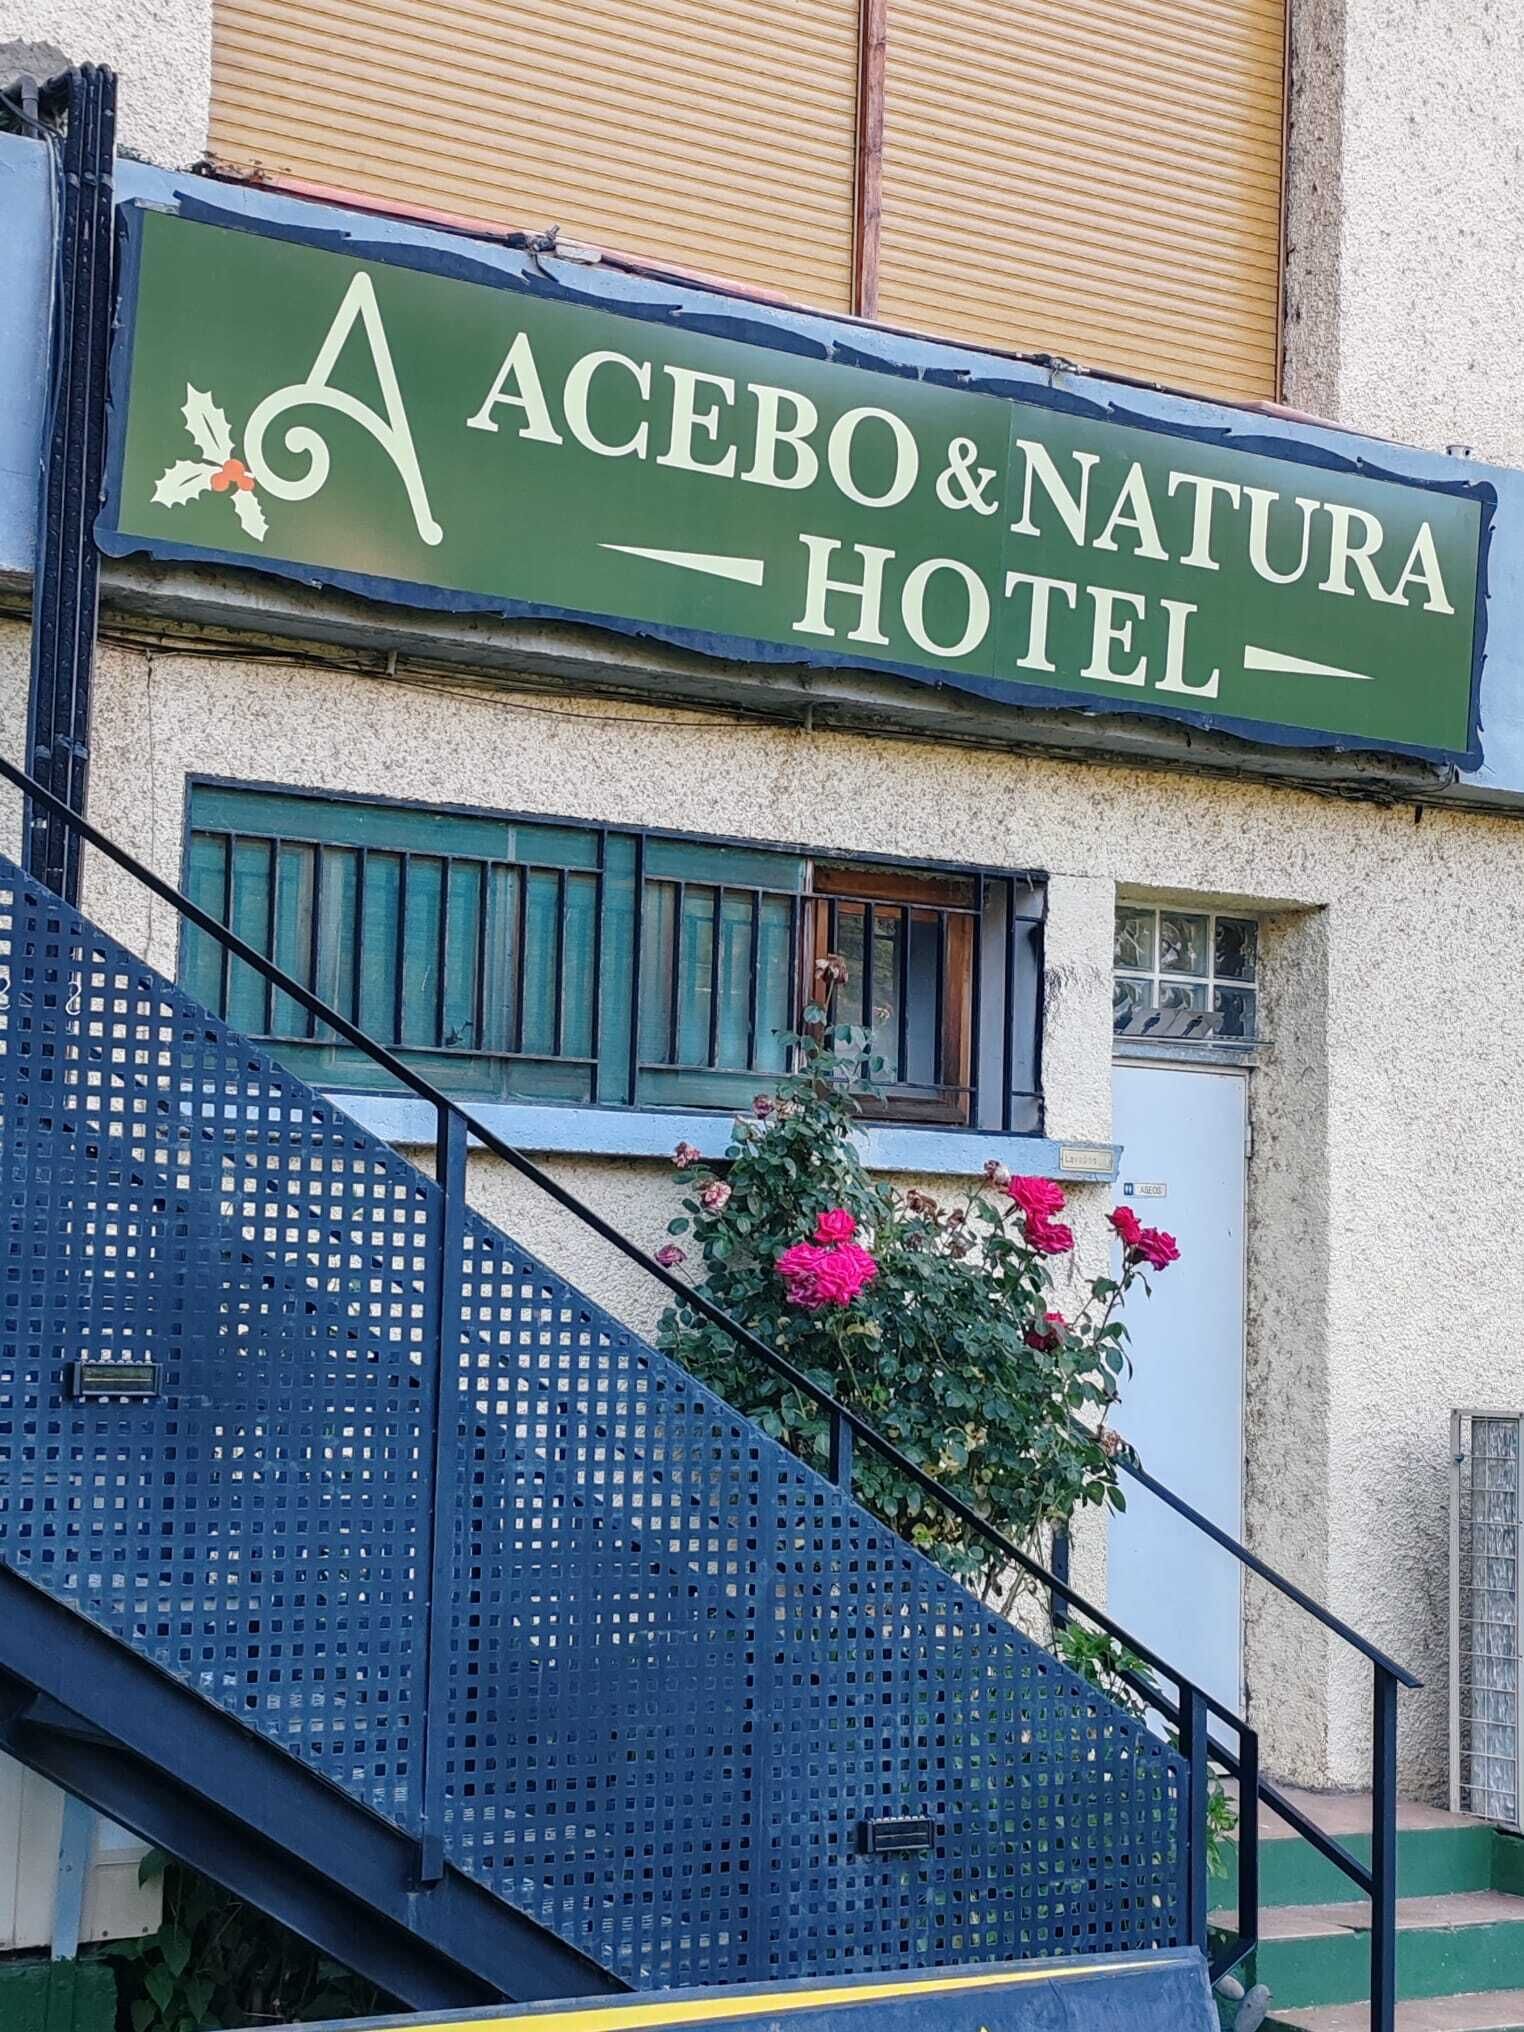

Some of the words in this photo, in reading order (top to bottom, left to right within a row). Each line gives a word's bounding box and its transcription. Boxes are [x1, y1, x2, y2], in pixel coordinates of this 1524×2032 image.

[466, 331, 920, 509] ACEBO
[1010, 438, 1455, 616] NATURA
[791, 532, 1220, 699] HOTEL
